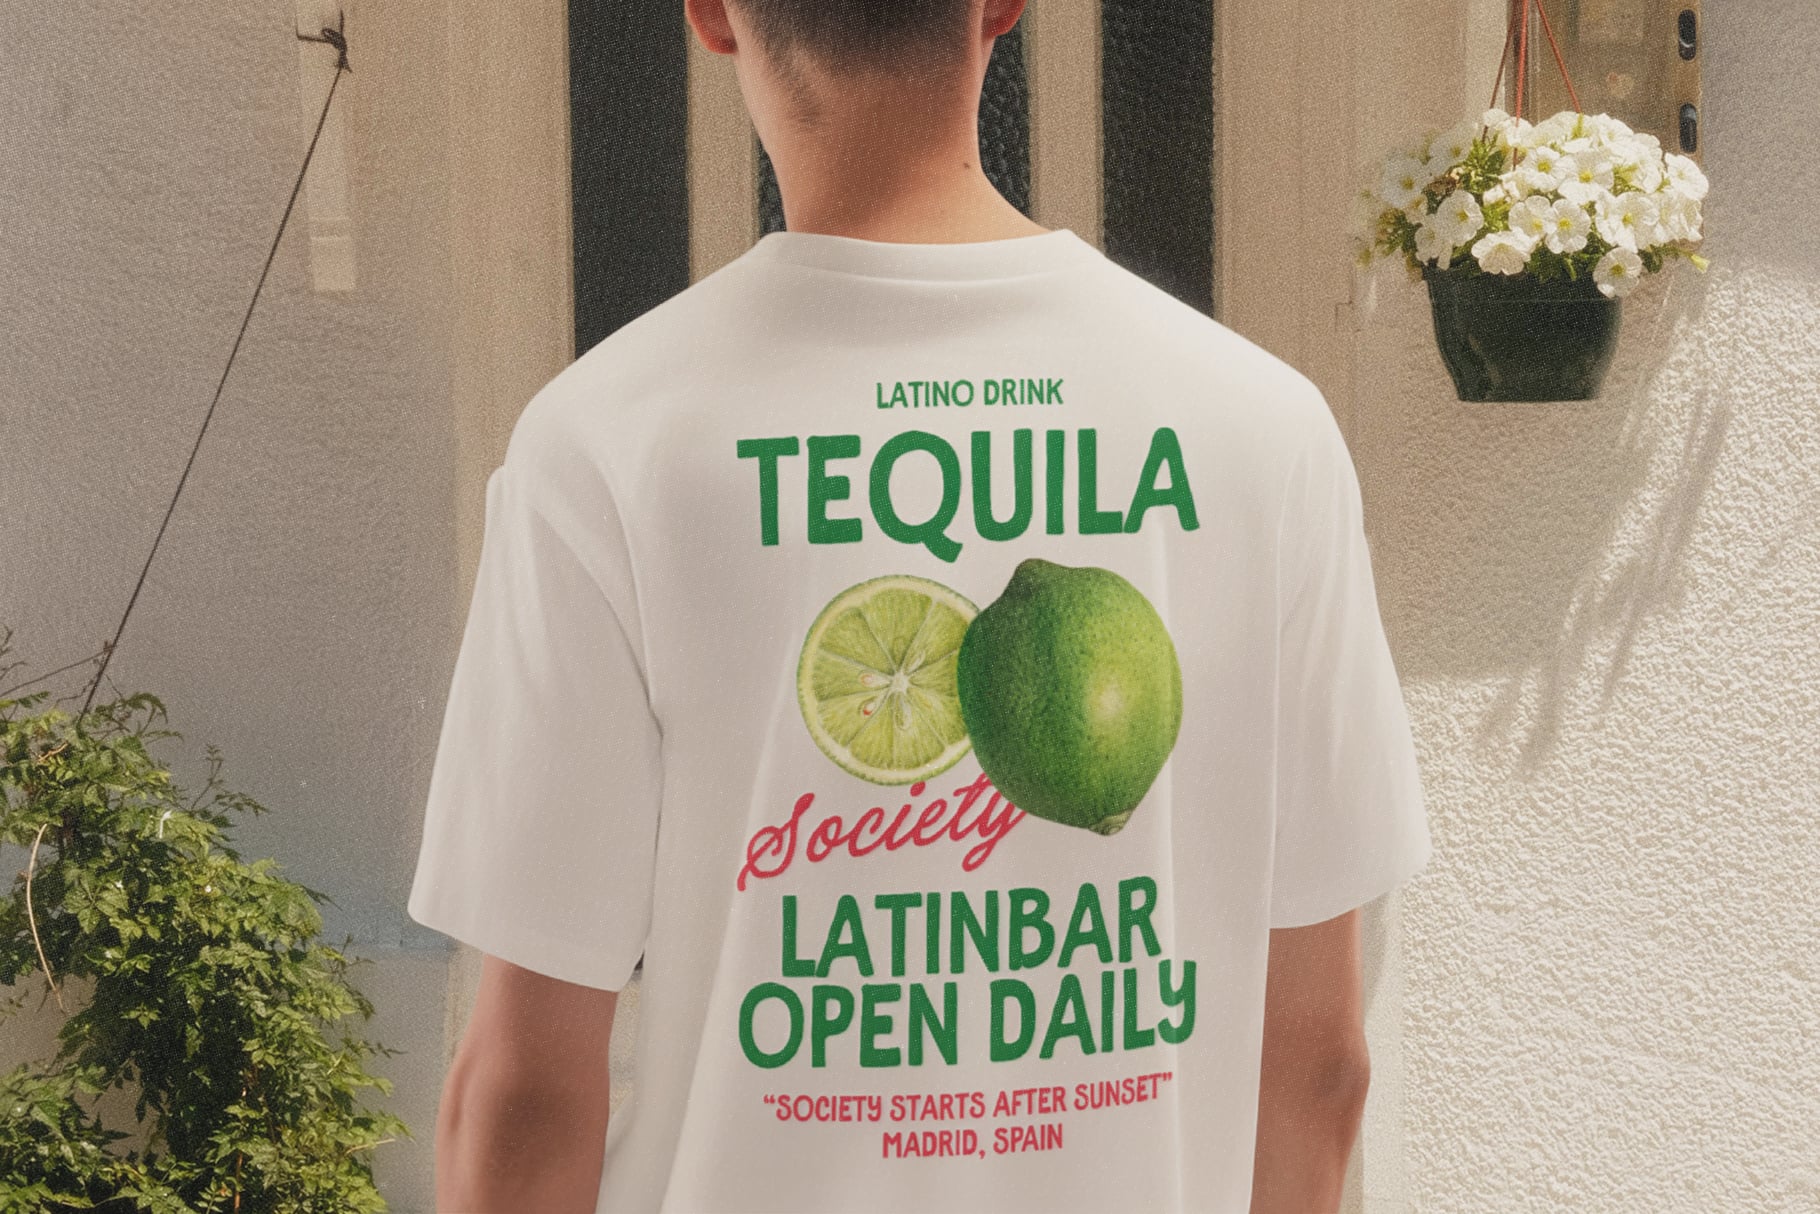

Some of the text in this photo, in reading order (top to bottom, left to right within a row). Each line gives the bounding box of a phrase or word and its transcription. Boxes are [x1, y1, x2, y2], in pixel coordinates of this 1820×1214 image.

[876, 378, 1064, 409] LATINO DRINK
[736, 427, 1200, 563] TEQUILA
[736, 772, 1027, 893] Society
[781, 876, 1162, 978] LATINBAR
[738, 959, 1197, 1069] OPEN DAILY
[882, 1122, 1063, 1160] MADRID, SPAIN
[889, 1091, 986, 1122] STARTS
[992, 1085, 1067, 1118] AFTER
[1073, 1071, 1174, 1111] SUNSET”
